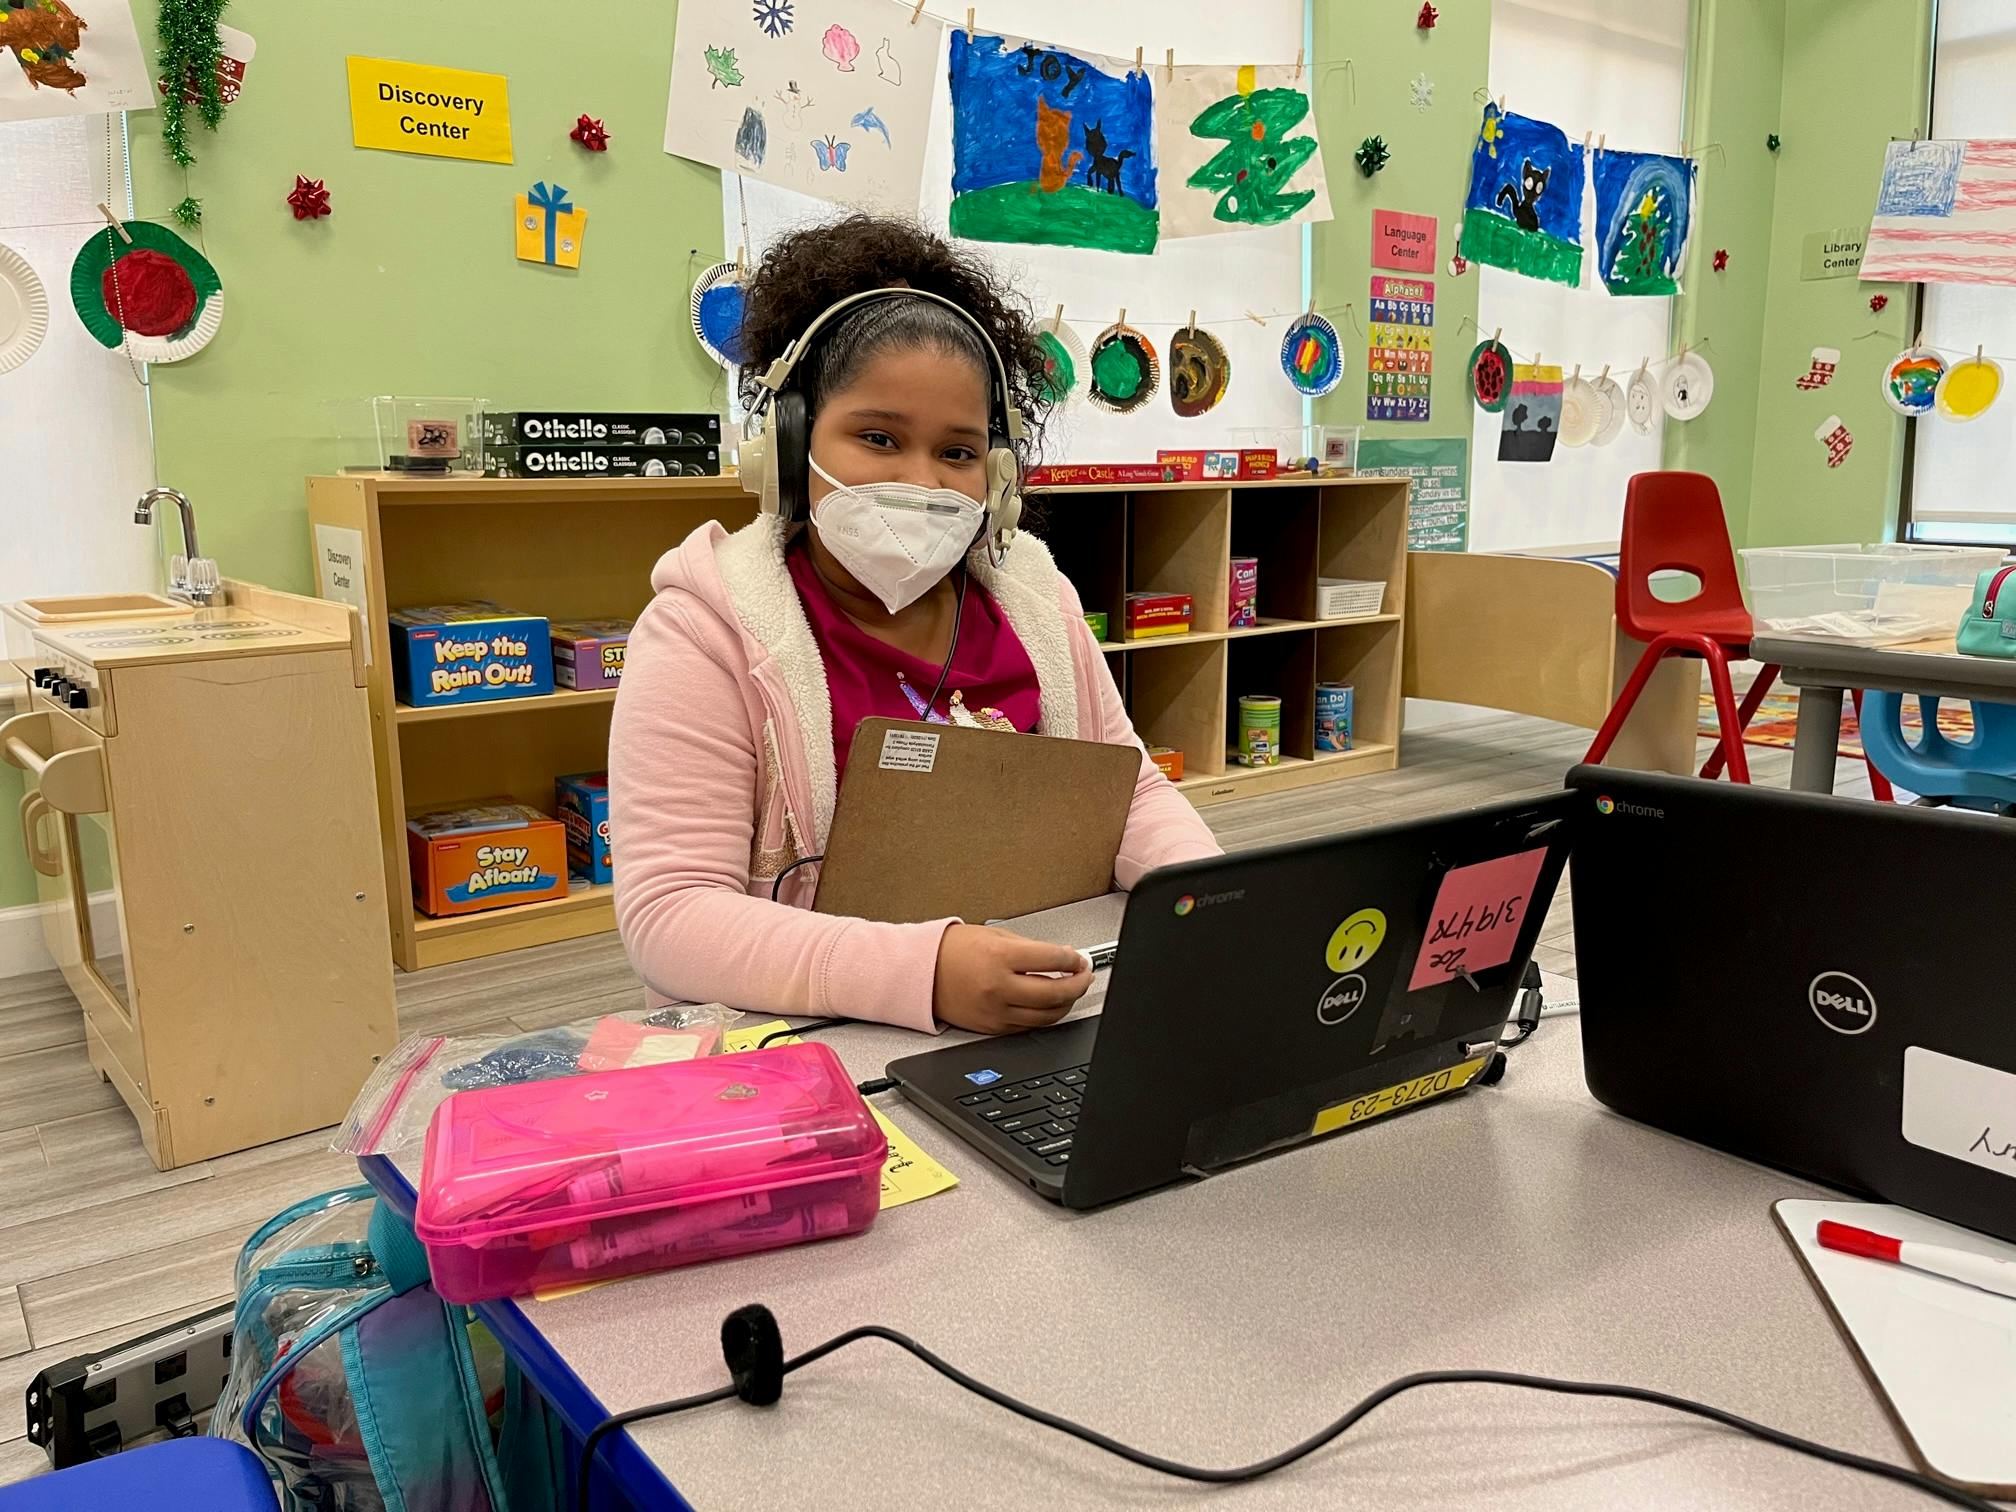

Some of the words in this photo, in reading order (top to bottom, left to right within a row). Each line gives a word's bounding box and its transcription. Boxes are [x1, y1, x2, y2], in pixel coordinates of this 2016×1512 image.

[1018, 46, 1086, 98] JOY
[378, 82, 484, 116] Discovery
[400, 115, 470, 140] Center
[1384, 224, 1427, 242] Language
[1391, 245, 1419, 259] Center
[1823, 242, 1862, 254] Library
[1823, 258, 1860, 269] Center
[1384, 284, 1423, 297] Alphabet
[1375, 299, 1385, 309] Aa
[1388, 300, 1397, 310] Bb
[1399, 301, 1409, 312] Cc
[1411, 303, 1420, 312] Dd
[1422, 304, 1431, 314] Ee
[1374, 349, 1381, 358] Ll
[1384, 349, 1396, 359] Mm
[1398, 350, 1406, 359] Nn
[1409, 351, 1419, 360] Oo
[1421, 351, 1429, 362] Pp
[1373, 373, 1383, 384] Qq
[1386, 373, 1394, 382] Rr
[1398, 374, 1405, 383] Ss
[1409, 374, 1416, 384] Tt
[1419, 375, 1428, 384] Uu
[1372, 396, 1381, 406] Vv
[1384, 397, 1396, 406] Ww
[1398, 398, 1406, 407] Xx
[1409, 399, 1417, 409] Yy
[1419, 399, 1427, 408] Zz
[524, 419, 608, 439] Othello
[526, 451, 609, 471] Othello
[1051, 468, 1078, 482] Keeper
[1088, 466, 1114, 480] Castle
[327, 548, 352, 571] Discovery
[333, 572, 350, 589] Center
[1236, 569, 1254, 579] Can
[434, 638, 488, 664] Keep
[491, 636, 527, 657] the
[431, 666, 482, 693] Rain
[485, 663, 533, 686] Out!
[1616, 800, 1666, 819] chrome
[476, 846, 529, 867] Stay
[468, 866, 540, 894] Afloat!
[1197, 889, 1246, 908] chrome
[1428, 896, 1522, 945] 319478
[1430, 947, 1467, 973] Zoe
[1323, 989, 1360, 1010] DELL
[1816, 989, 1869, 1016] DELL
[1349, 1070, 1452, 1121] D273-23
